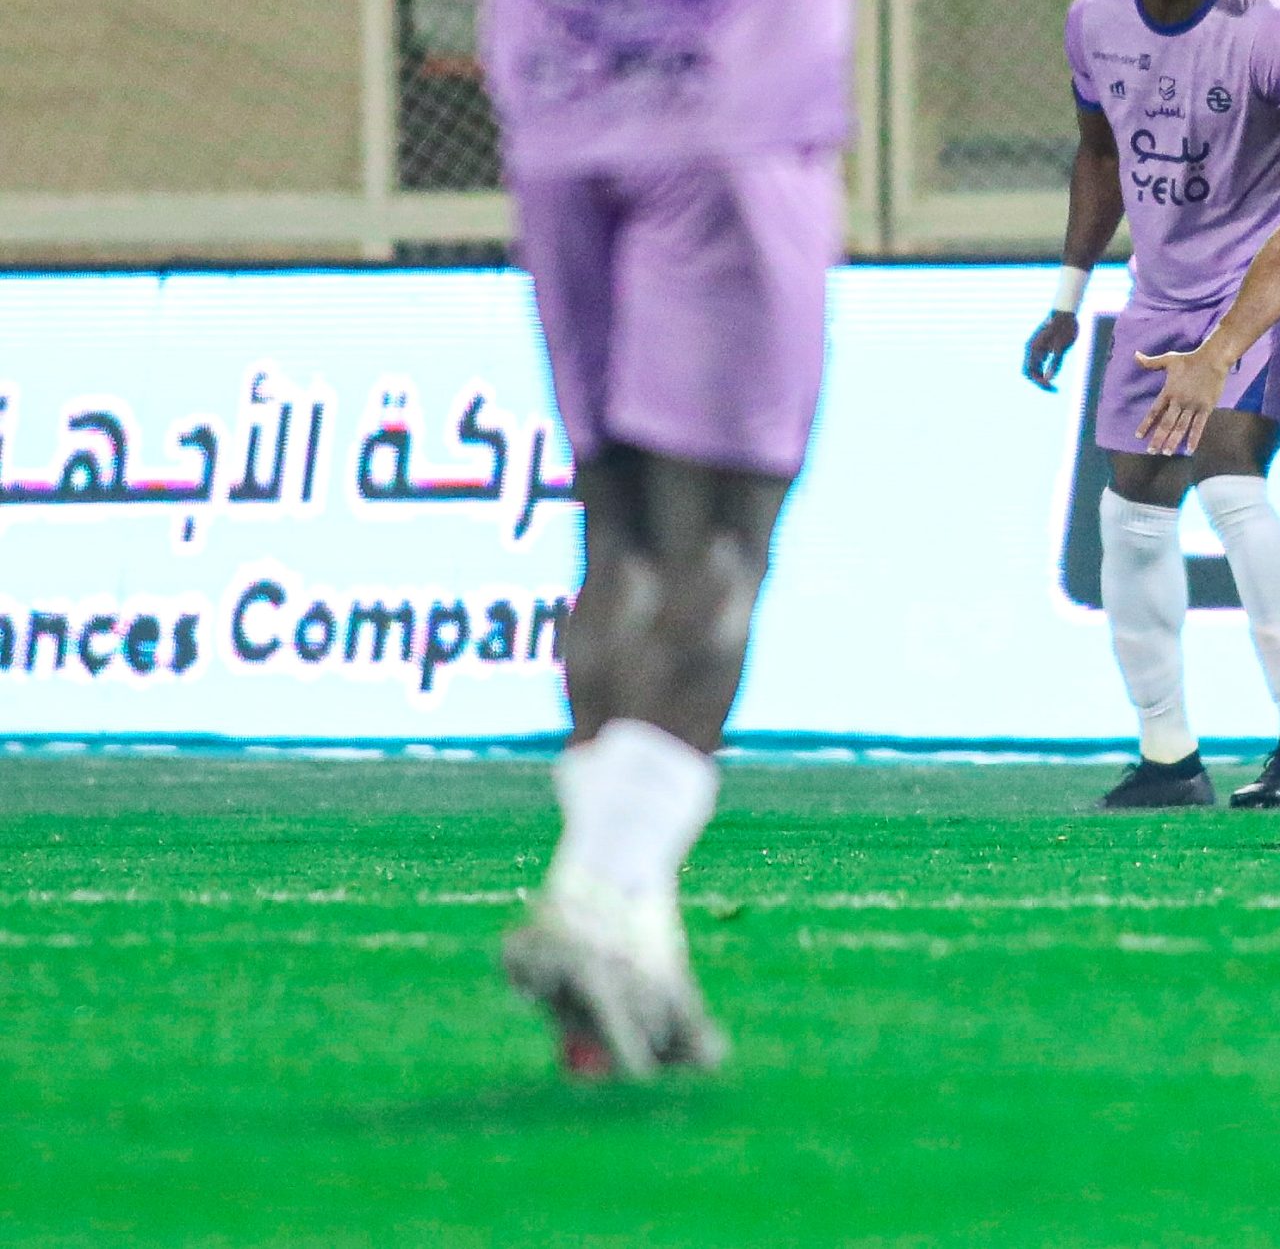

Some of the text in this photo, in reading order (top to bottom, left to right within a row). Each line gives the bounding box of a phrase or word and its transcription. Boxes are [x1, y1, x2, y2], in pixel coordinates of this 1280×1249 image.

[1131, 171, 1211, 206] YELO
[357, 393, 576, 540] ركة
[230, 578, 572, 693] Compan
